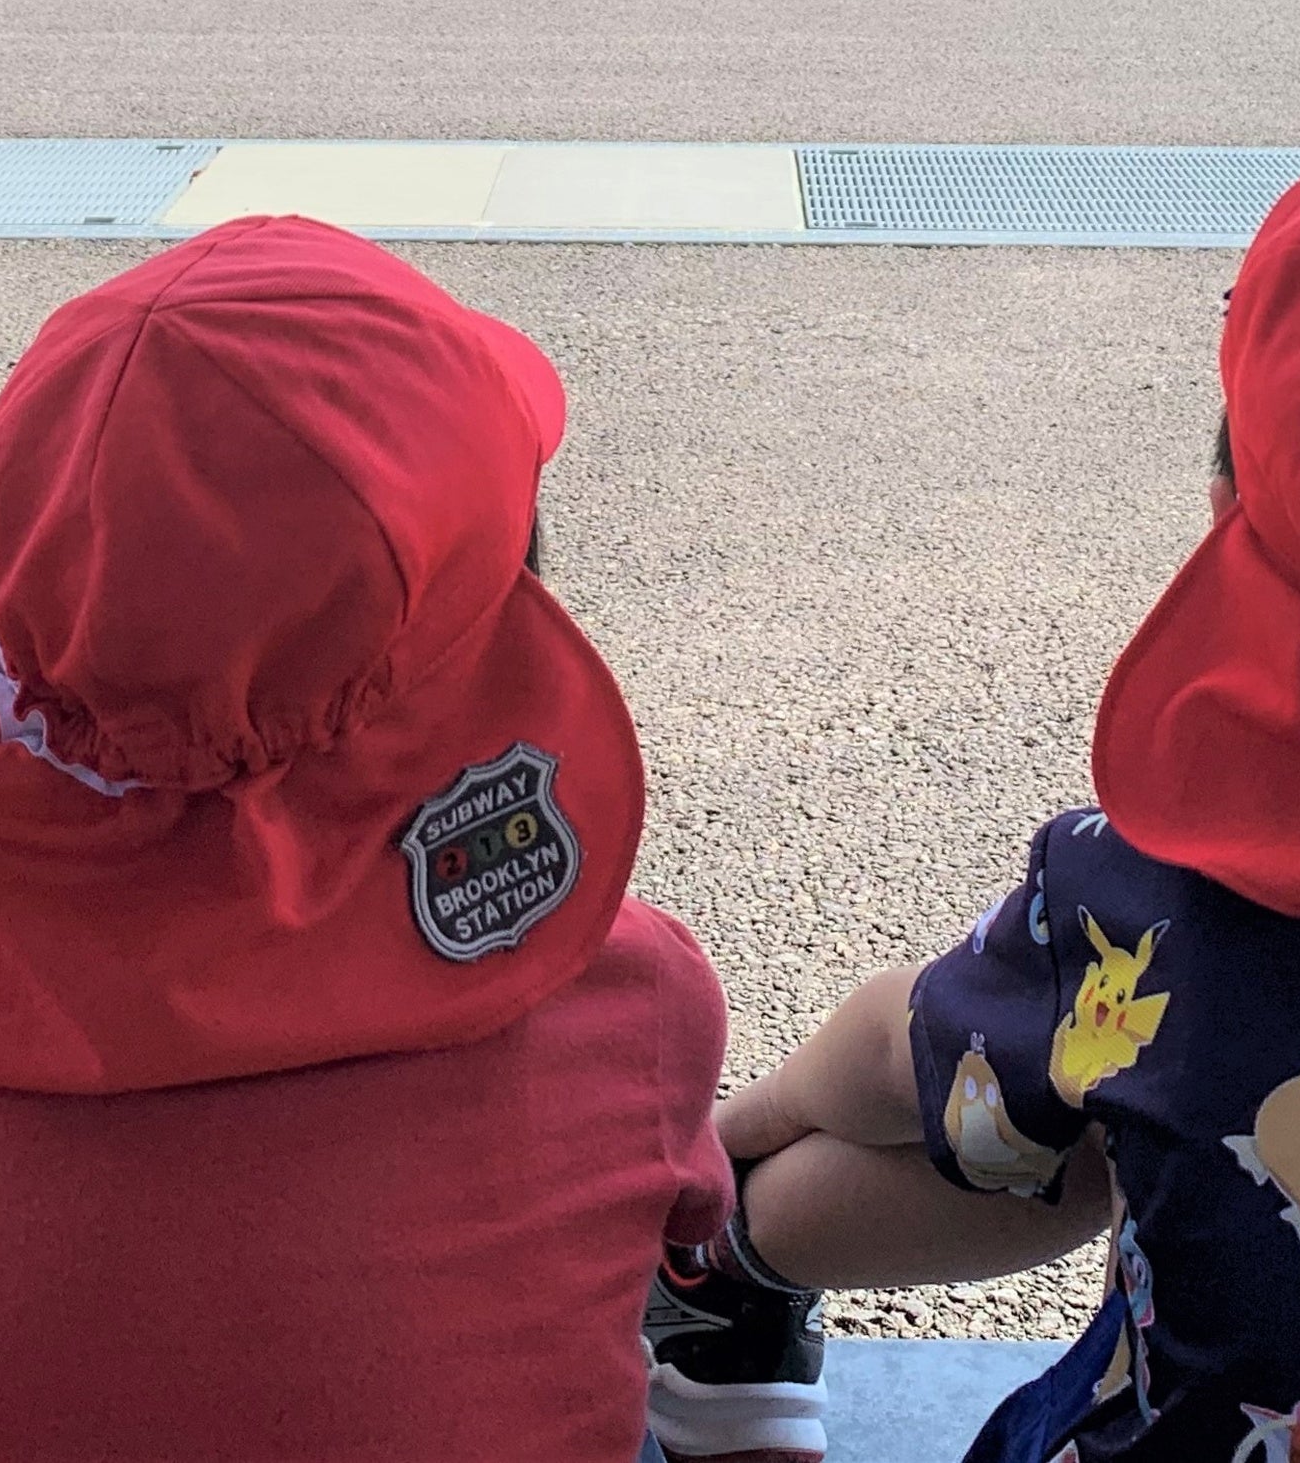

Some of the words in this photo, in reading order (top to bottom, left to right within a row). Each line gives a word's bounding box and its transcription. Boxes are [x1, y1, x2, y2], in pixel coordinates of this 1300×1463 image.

[426, 772, 529, 841] SUBWAY
[435, 842, 560, 918] BROOKLYN
[445, 851, 459, 878] 2
[513, 819, 532, 843] 3
[455, 873, 555, 938] STATION
